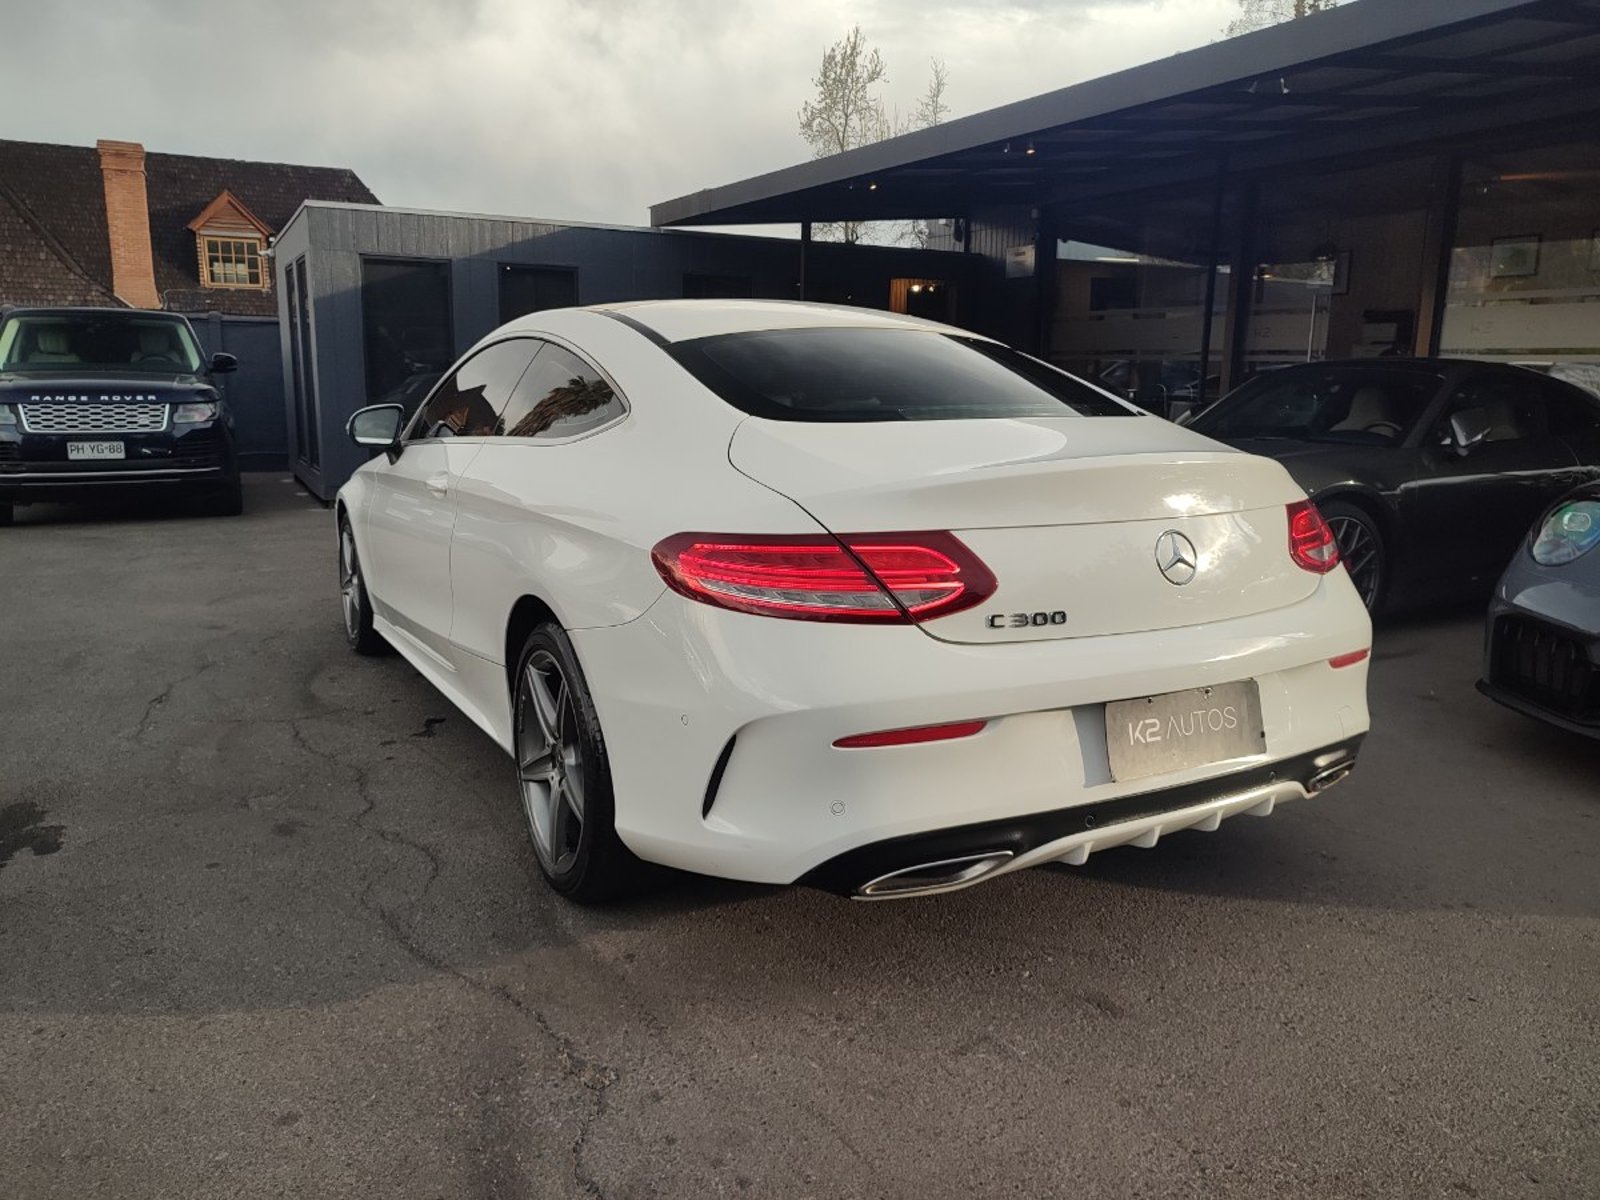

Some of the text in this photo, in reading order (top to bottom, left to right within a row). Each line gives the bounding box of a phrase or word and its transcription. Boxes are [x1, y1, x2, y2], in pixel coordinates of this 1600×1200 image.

[986, 611, 1067, 628] C 300
[1128, 706, 1237, 745] K2 AUTOS
